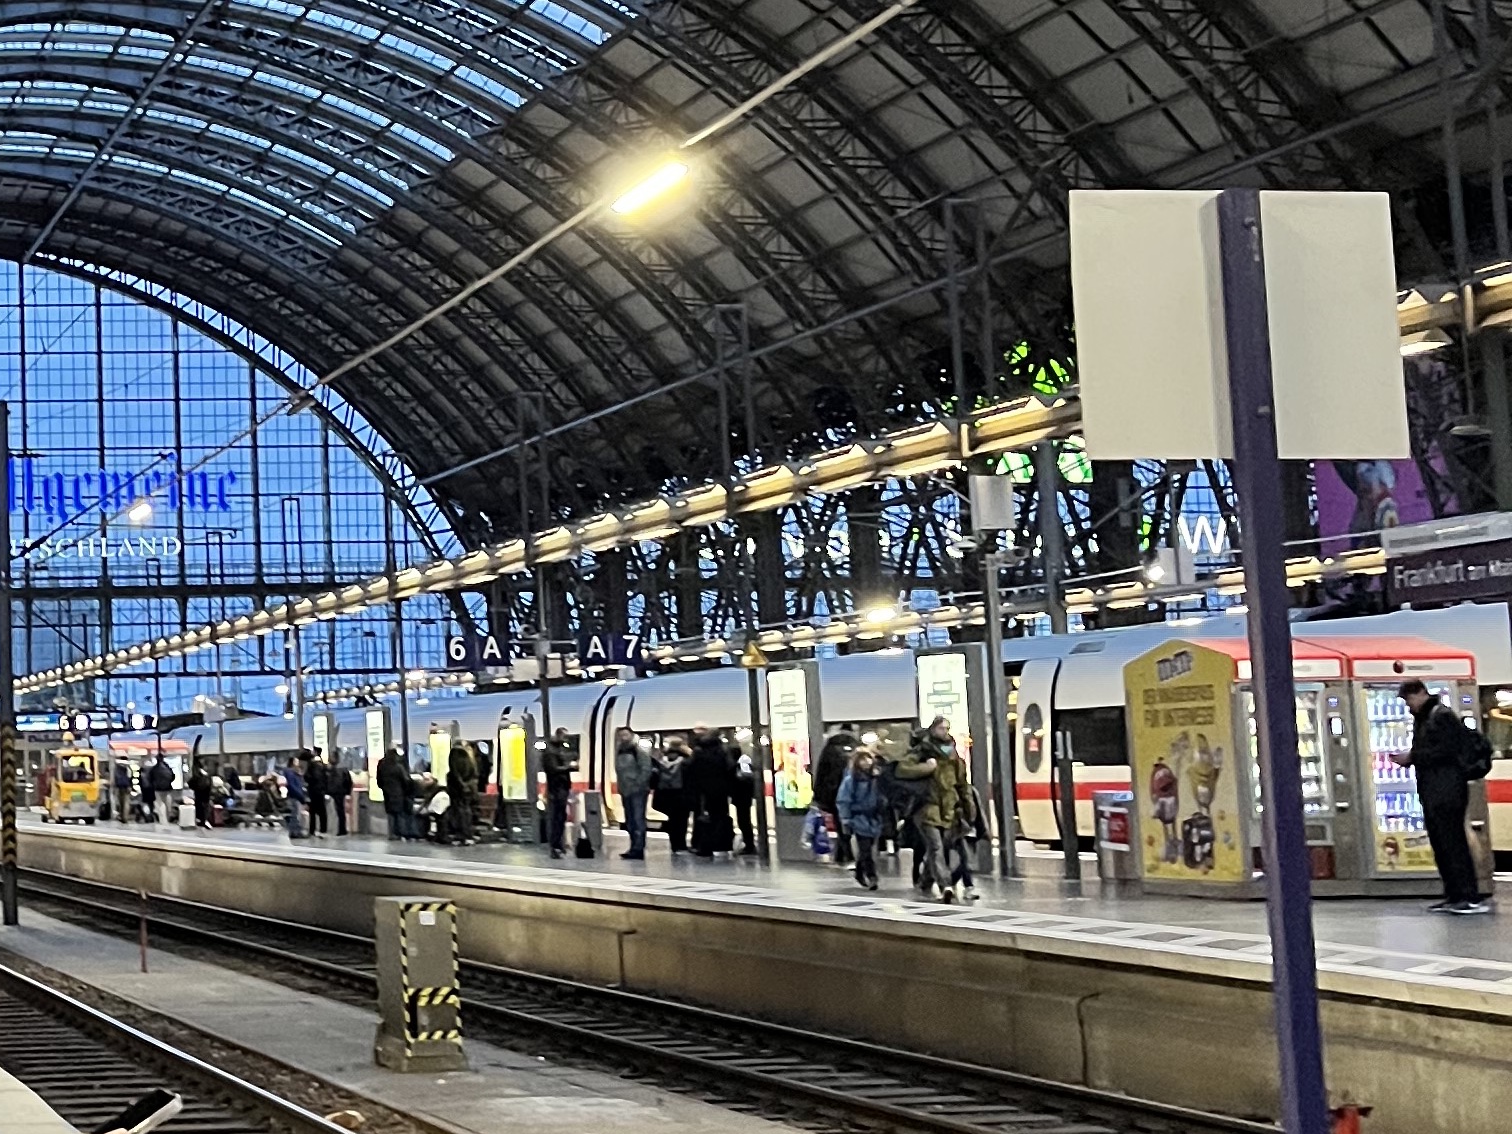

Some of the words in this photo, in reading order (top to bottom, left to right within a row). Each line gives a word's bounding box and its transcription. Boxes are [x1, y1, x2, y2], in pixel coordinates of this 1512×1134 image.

[1177, 514, 1226, 554] W
[449, 636, 466, 661] 6
[482, 636, 501, 659] A
[586, 635, 606, 659] A
[623, 635, 638, 659] 7
